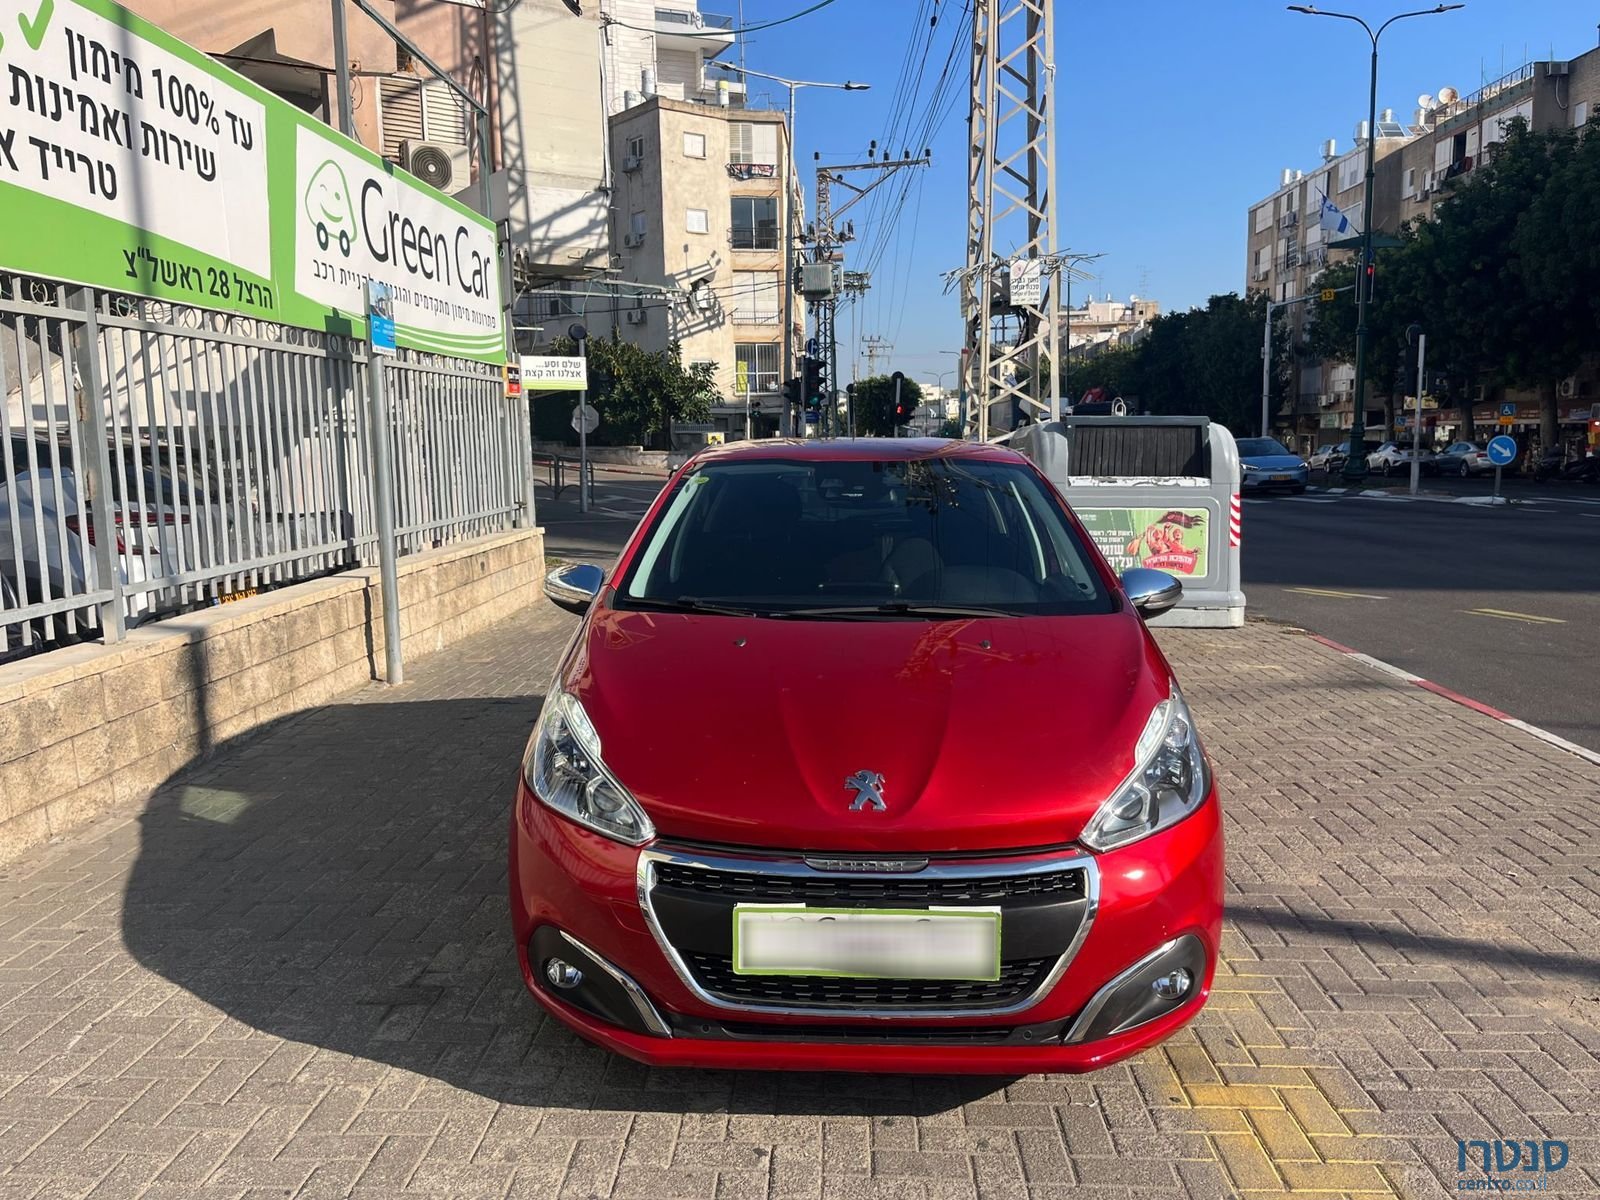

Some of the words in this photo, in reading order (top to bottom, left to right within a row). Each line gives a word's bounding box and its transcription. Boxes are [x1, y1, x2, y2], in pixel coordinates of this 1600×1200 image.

[65, 26, 143, 100] מימון
[8, 63, 133, 150] ואמינות
[152, 68, 220, 135] 100%
[224, 109, 253, 151] עד
[140, 120, 216, 182] שירות
[28, 135, 117, 200] טרייד
[361, 178, 451, 287] Green
[454, 226, 491, 300] Car
[207, 266, 230, 299] 28
[313, 259, 336, 282] רכב
[233, 272, 273, 310] הרצל
[414, 291, 450, 316] מתקדמים
[1323, 291, 1332, 299] 13
[451, 303, 470, 321] מימון
[471, 308, 496, 329] פתרונות
[525, 369, 543, 379] קצת
[545, 369, 555, 377] זה
[557, 369, 581, 378] אצלנו
[562, 360, 581, 369] שלם
